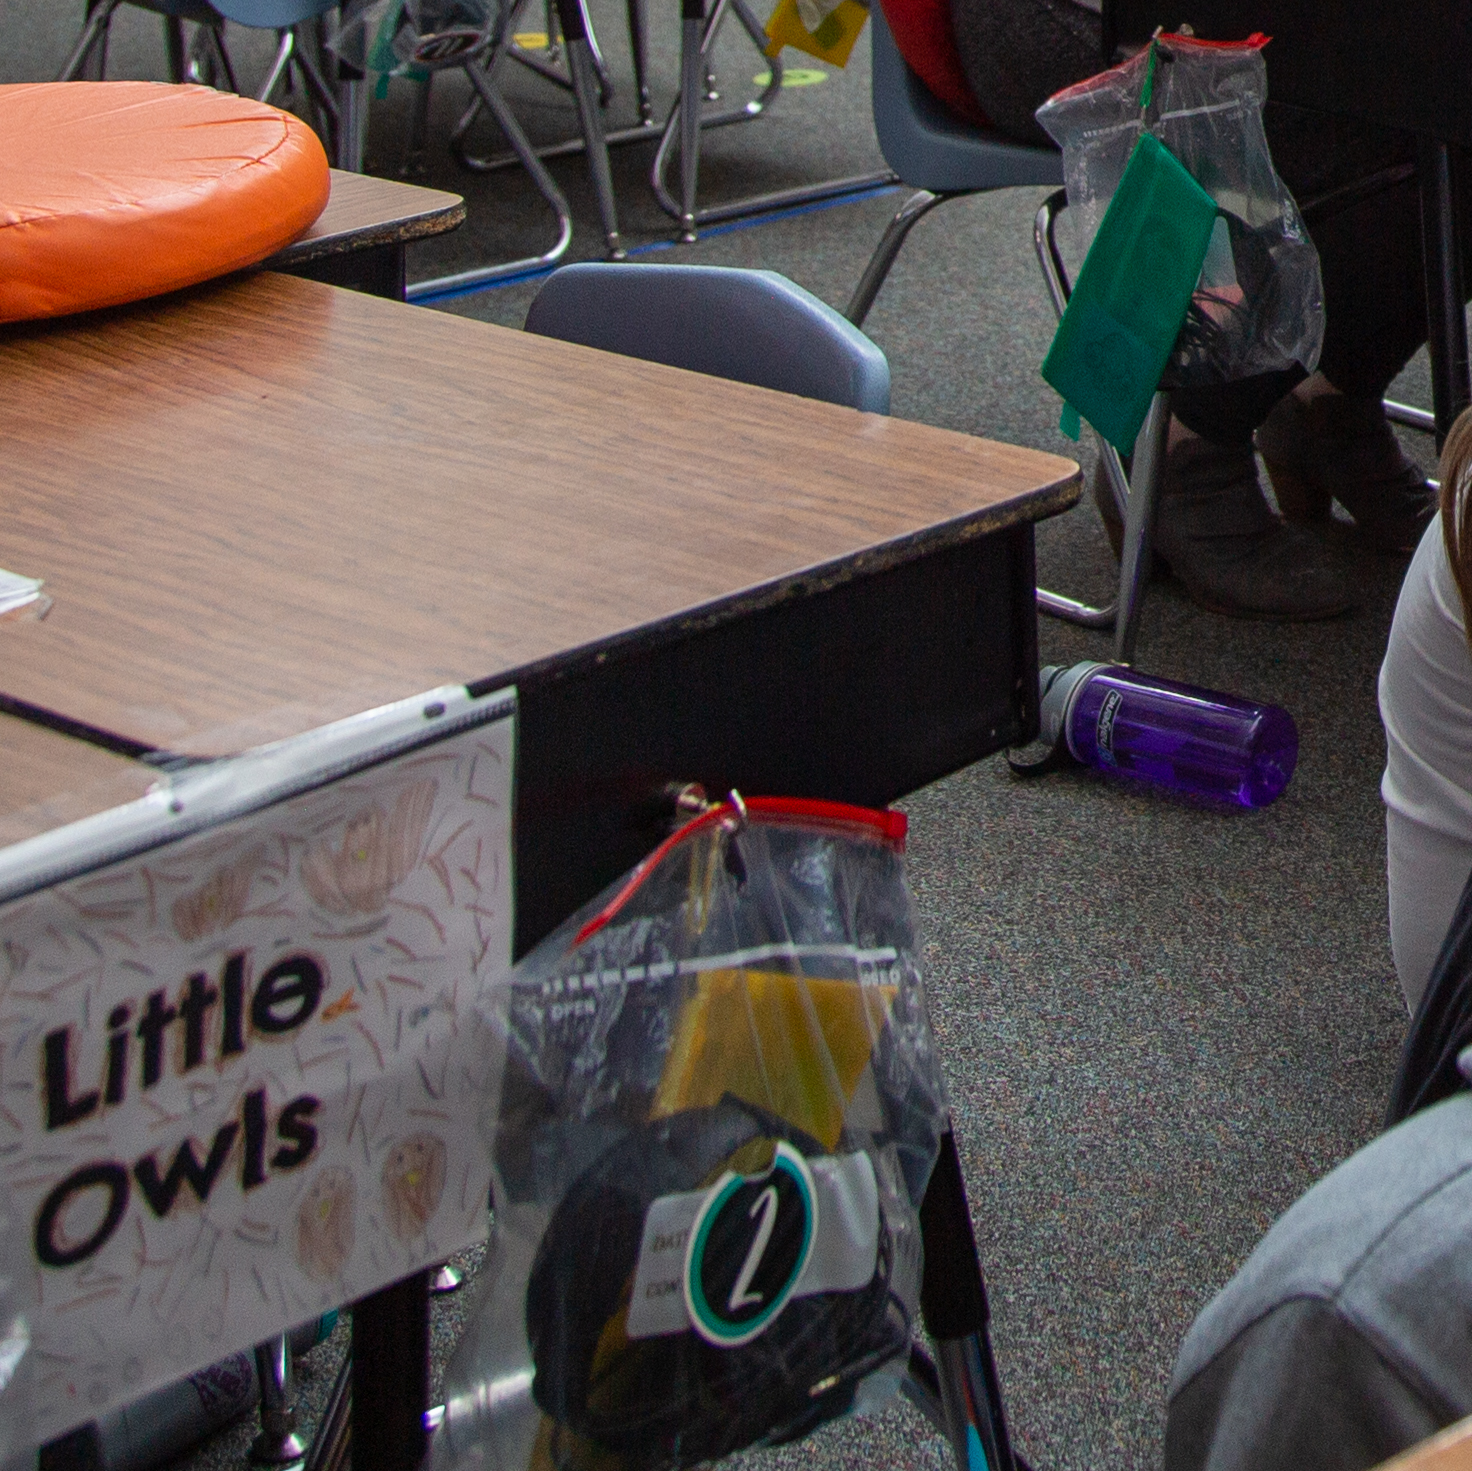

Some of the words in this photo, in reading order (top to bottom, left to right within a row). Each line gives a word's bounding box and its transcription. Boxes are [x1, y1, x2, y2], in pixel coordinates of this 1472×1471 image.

[41, 950, 326, 1130] Little
[34, 1086, 323, 1269] Owls
[728, 1185, 779, 1312] 2
